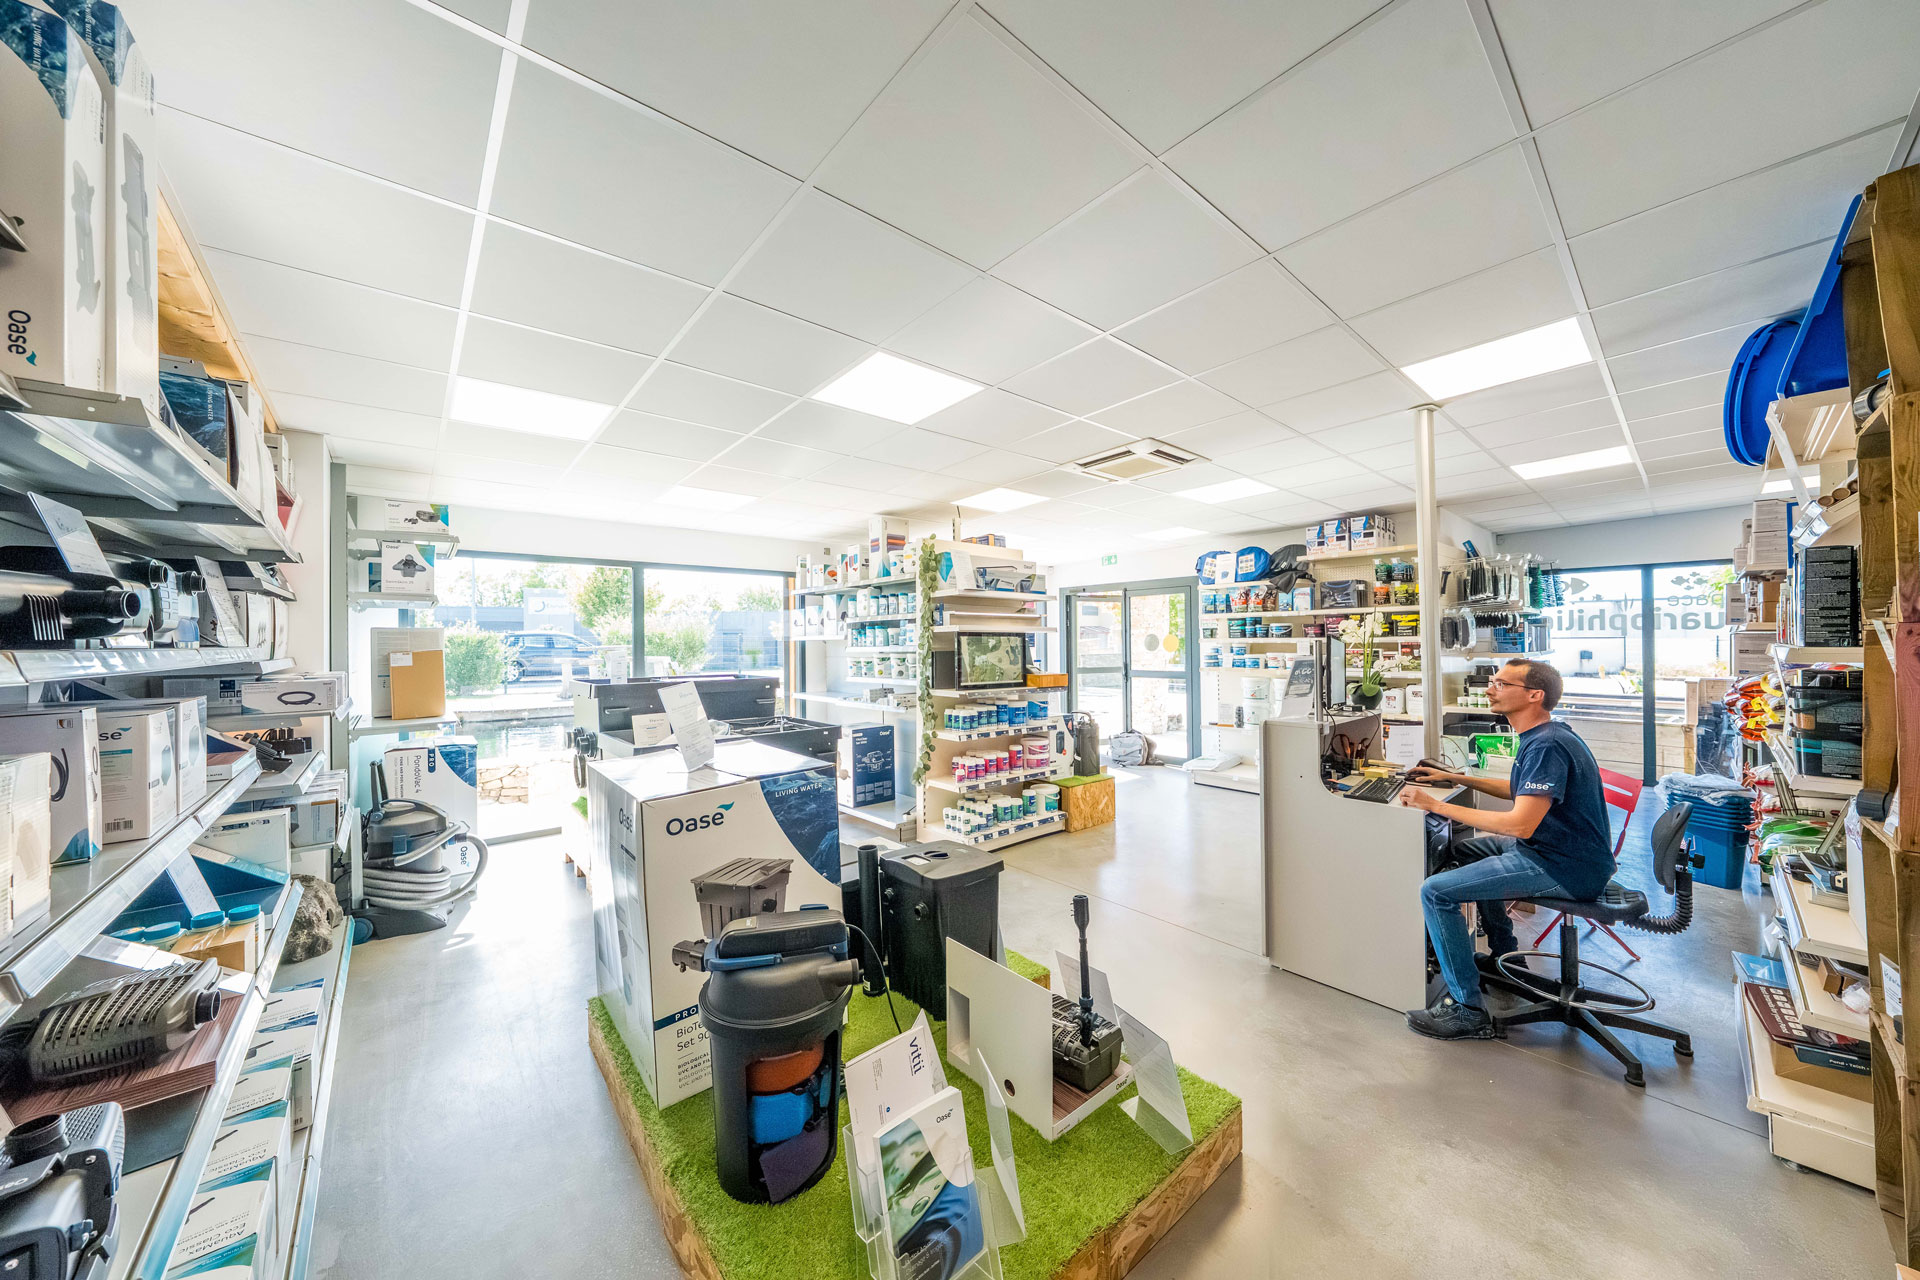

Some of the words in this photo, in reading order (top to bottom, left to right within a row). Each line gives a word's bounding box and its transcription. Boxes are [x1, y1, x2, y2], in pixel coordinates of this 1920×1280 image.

[8, 309, 32, 355] Oase
[414, 755, 422, 787] PondoVac
[775, 787, 798, 798] LIVING
[800, 782, 823, 792] WATER
[1524, 781, 1549, 790] Oase
[666, 811, 725, 836] Oase
[460, 845, 468, 865] Oase
[675, 1007, 697, 1021] PRO
[677, 1038, 695, 1052] Set
[678, 1068, 689, 1076] UVC
[690, 1062, 702, 1071] AND
[936, 1112, 952, 1124] Oase
[247, 1148, 267, 1158] Eco
[209, 1156, 246, 1173] Classic
[217, 1154, 267, 1174] AquaMax
[224, 1221, 247, 1235] Eco
[178, 1232, 222, 1254] Classic
[187, 1228, 246, 1256] AquaMax
